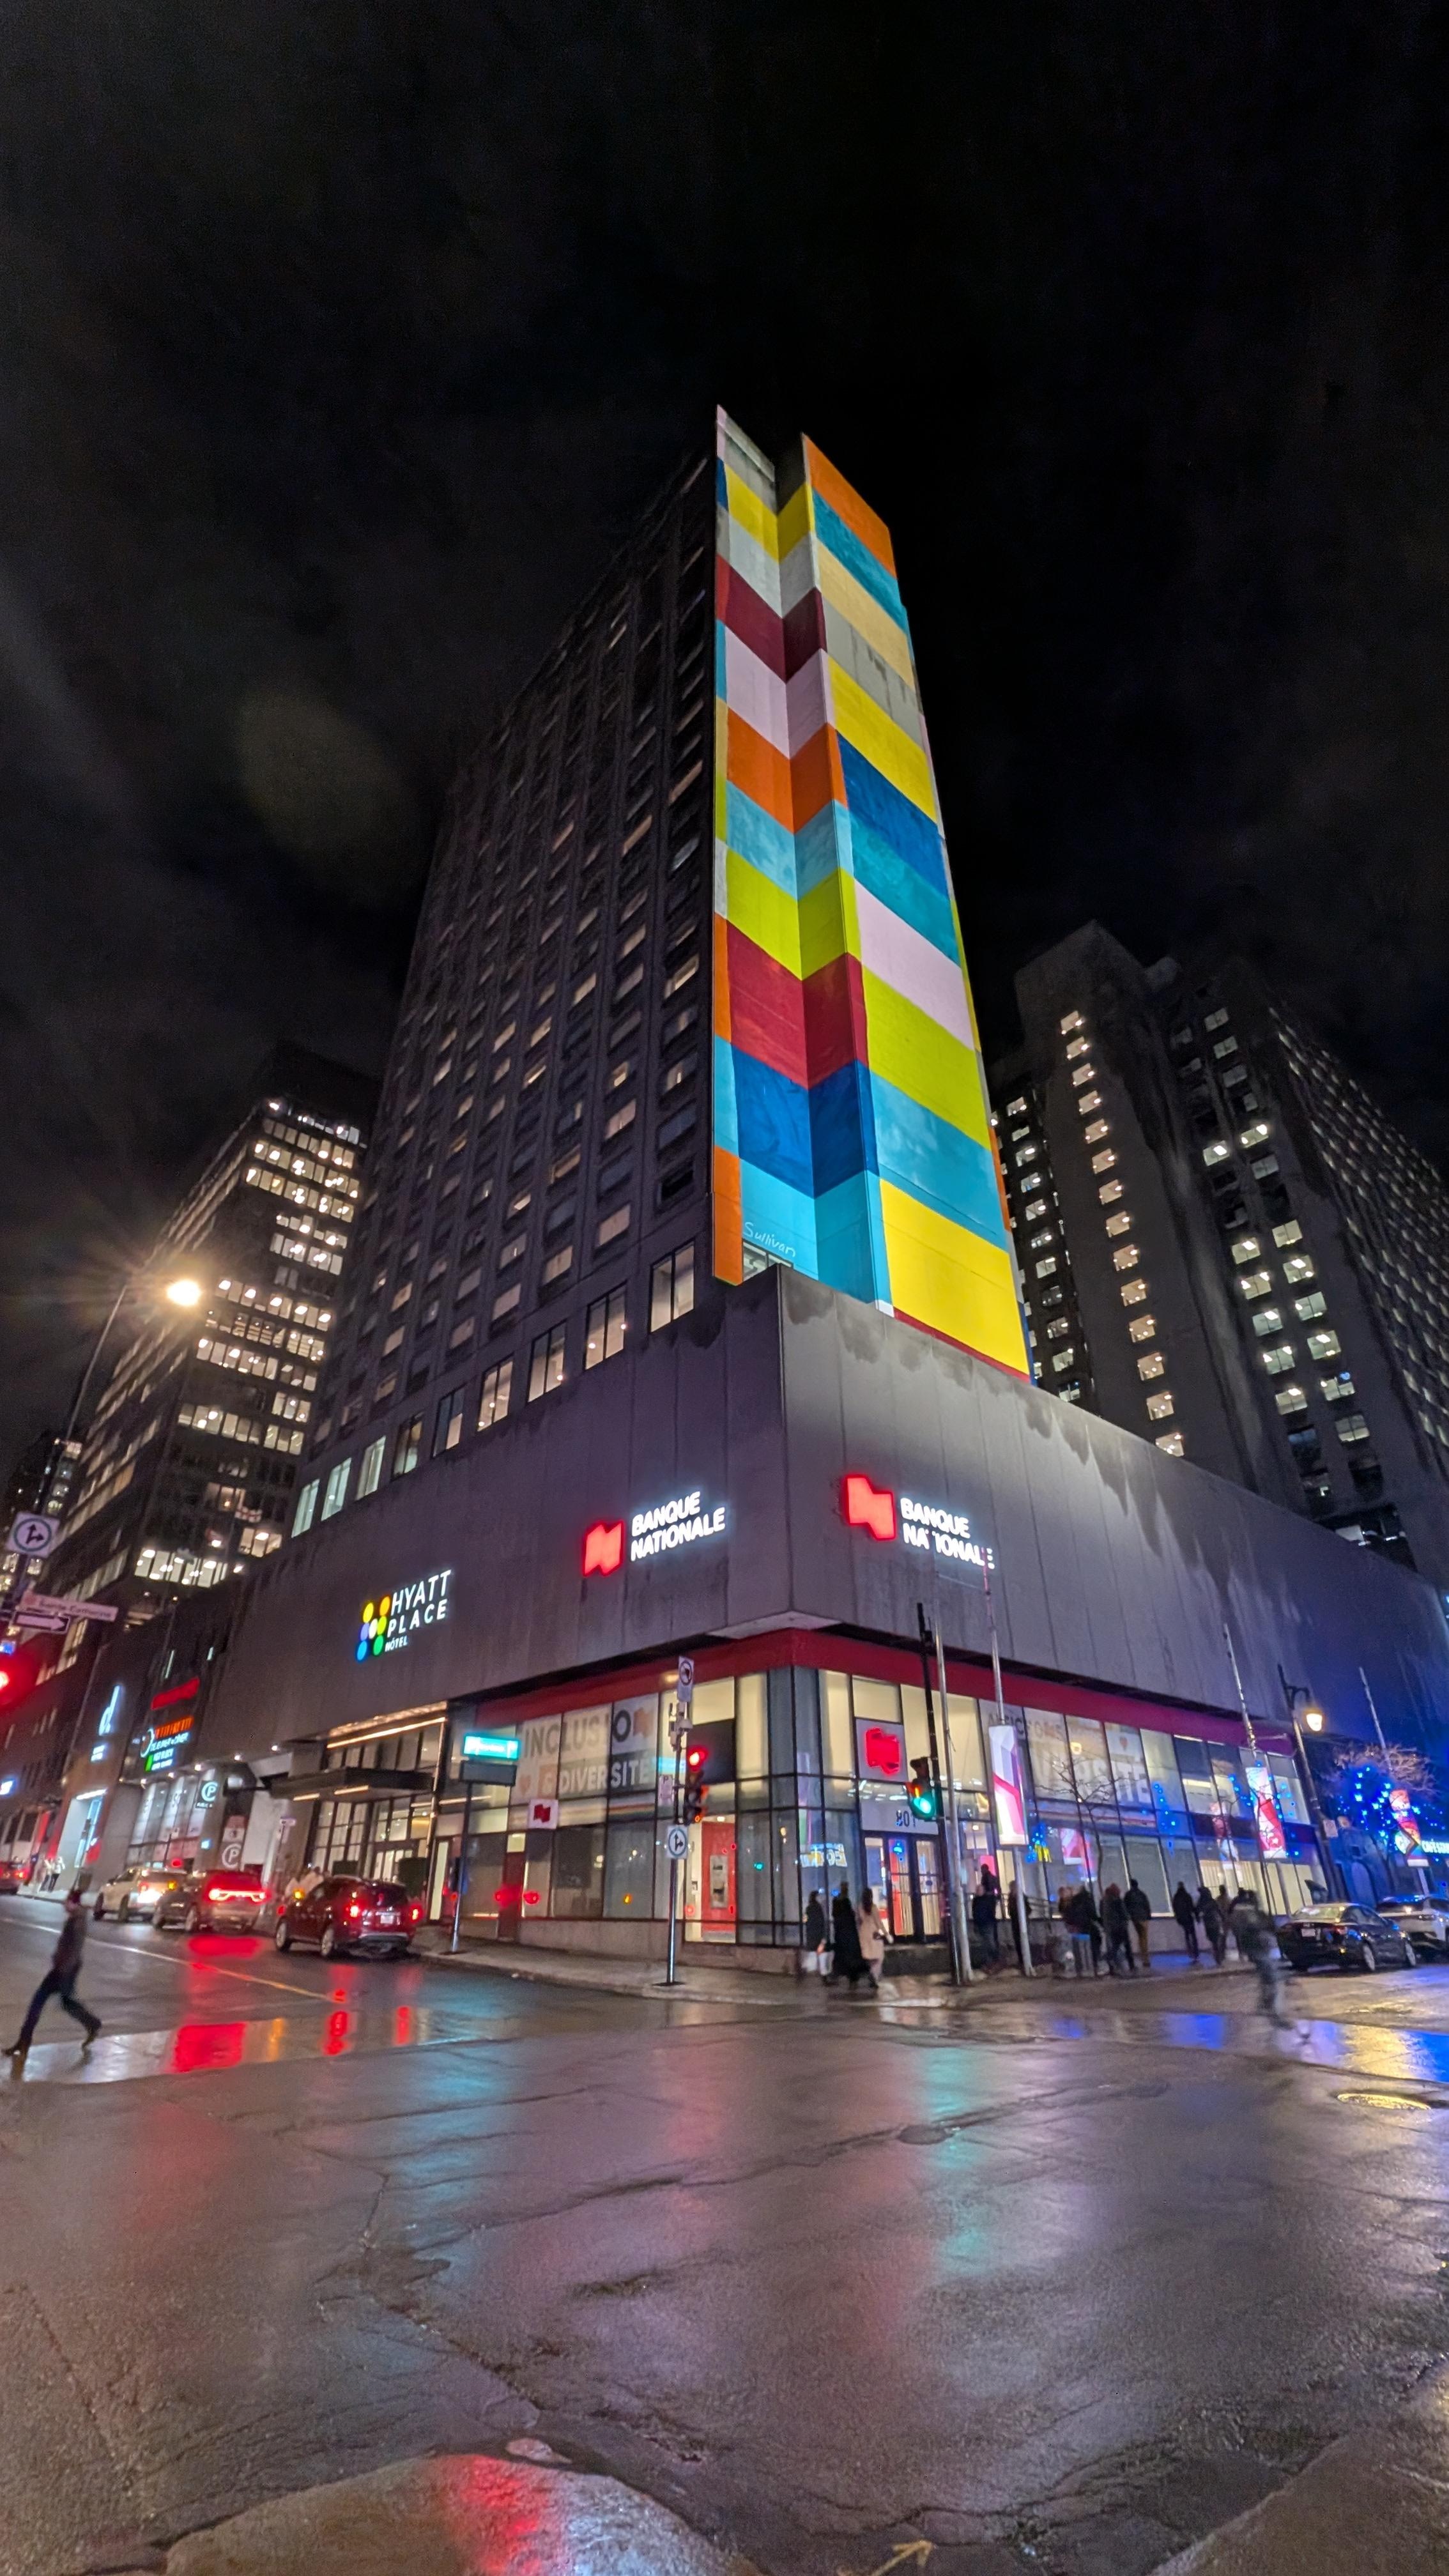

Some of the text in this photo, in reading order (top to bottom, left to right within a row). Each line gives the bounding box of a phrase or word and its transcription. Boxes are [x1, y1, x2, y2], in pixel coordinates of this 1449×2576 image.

[742, 1221, 797, 1258] Sullivan
[630, 1506, 726, 1562] NATIONALE
[631, 1491, 700, 1537] BANQUE
[900, 1497, 971, 1539] BANQUE
[390, 1568, 452, 1616] HYATT
[387, 1598, 448, 1638] PLACE
